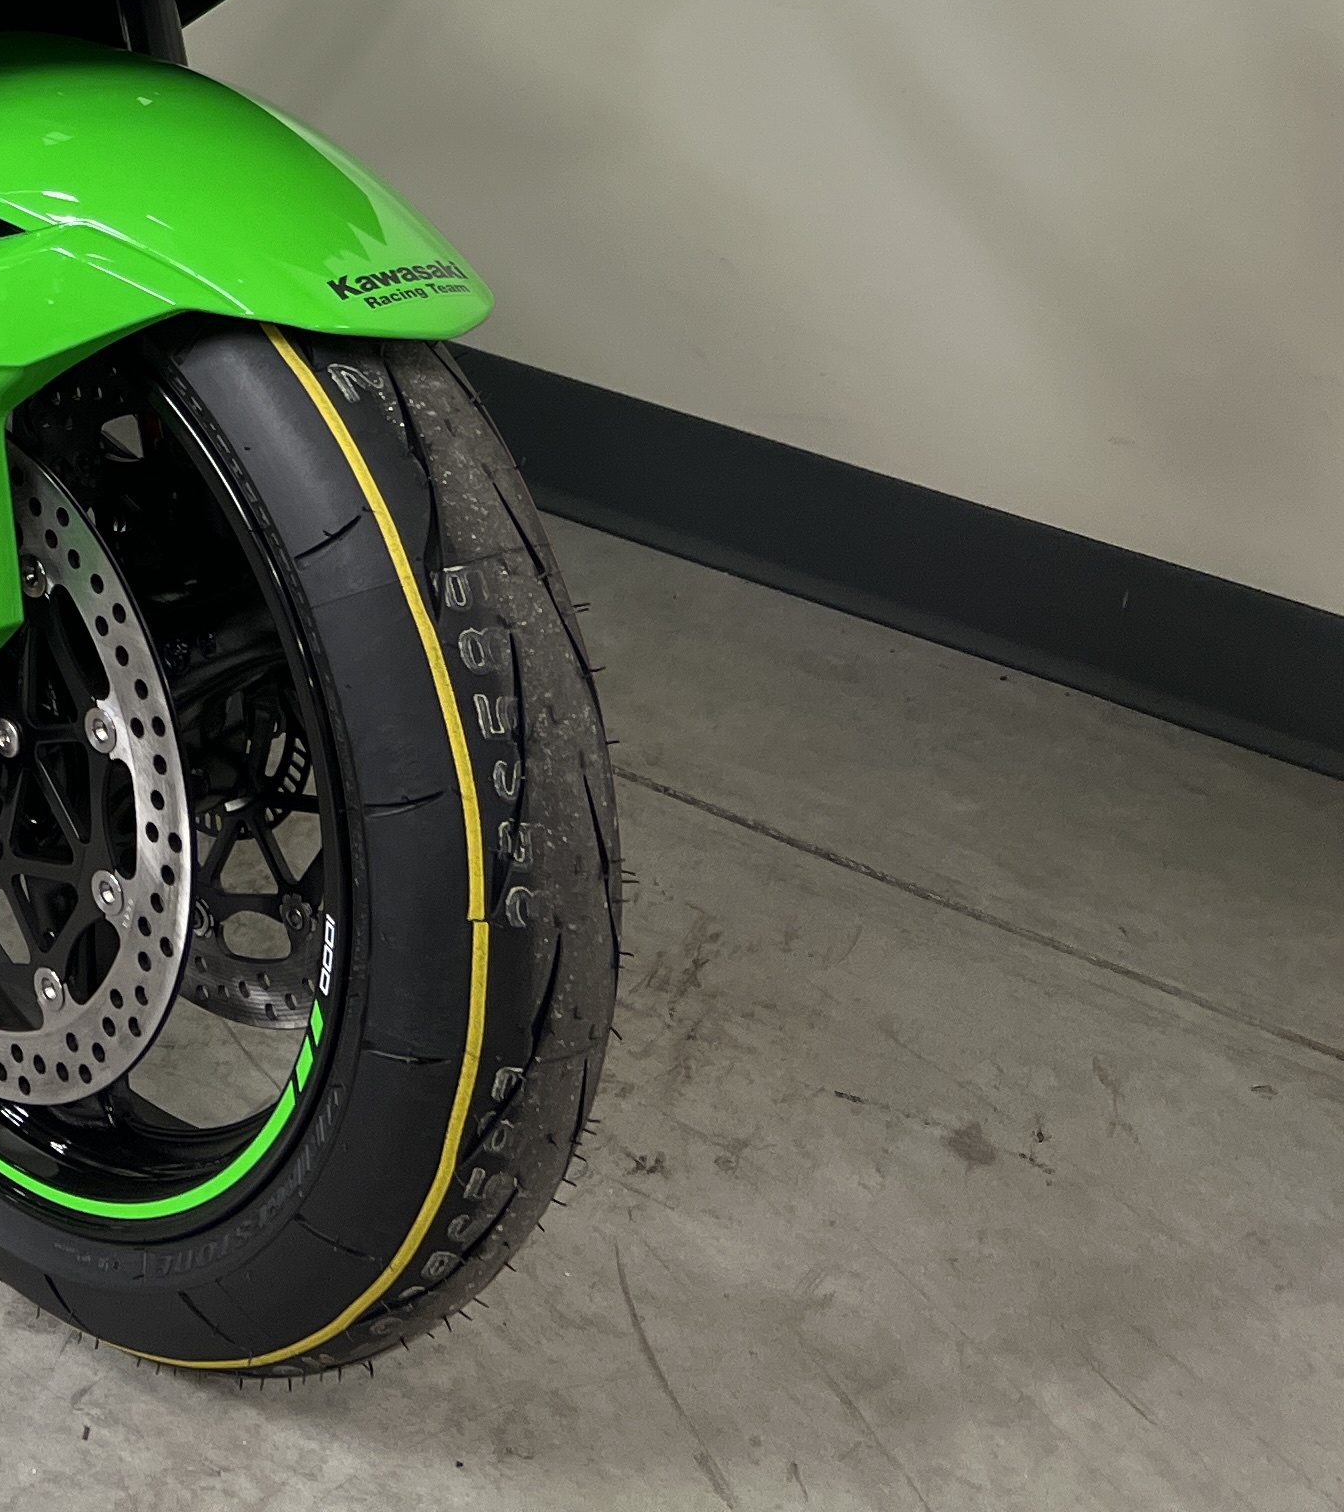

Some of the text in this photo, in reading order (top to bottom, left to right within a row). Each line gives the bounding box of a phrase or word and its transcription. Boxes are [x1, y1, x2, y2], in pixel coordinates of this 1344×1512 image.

[326, 259, 469, 301] Kawasaki
[363, 282, 471, 309] Racing Team
[319, 913, 336, 997] 1000
